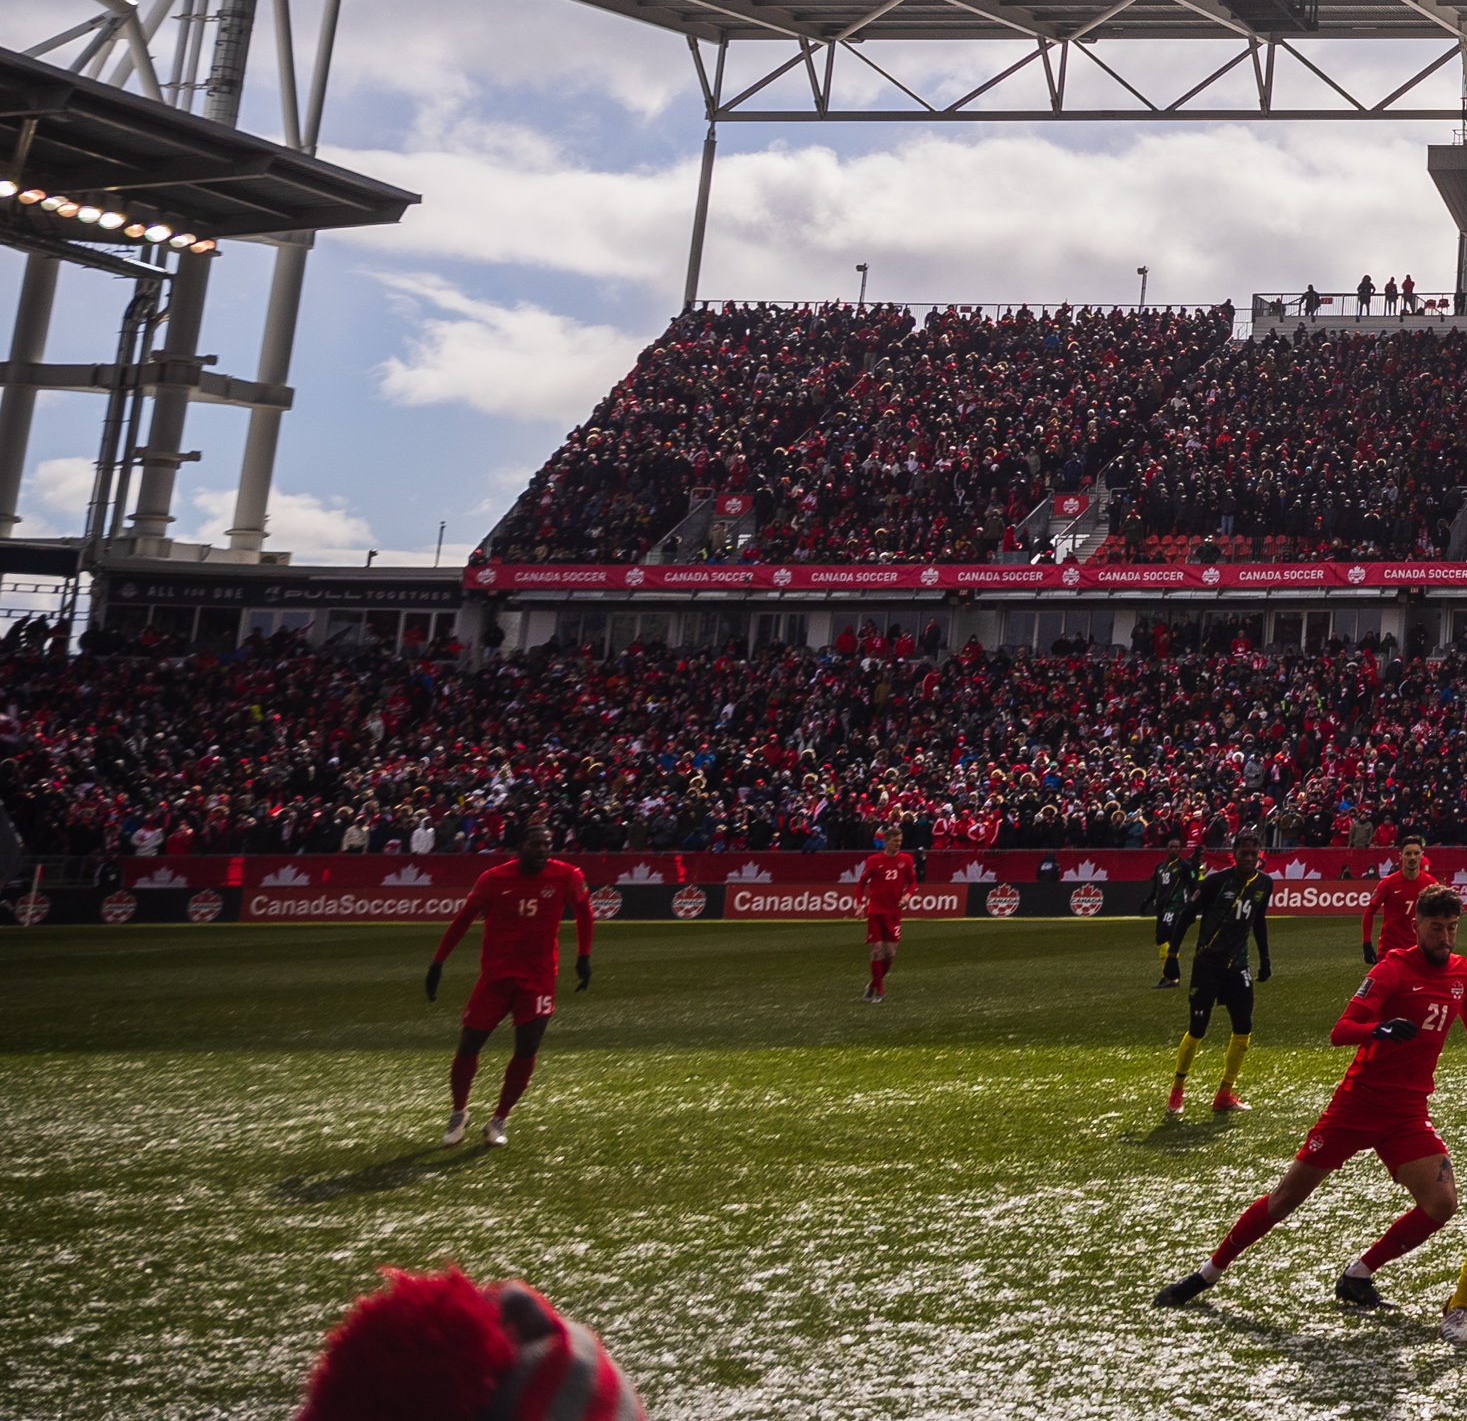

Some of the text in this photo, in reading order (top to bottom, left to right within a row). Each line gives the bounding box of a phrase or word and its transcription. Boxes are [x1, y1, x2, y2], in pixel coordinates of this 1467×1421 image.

[514, 572, 606, 581] CANADA SOCCER
[664, 572, 754, 582] CANADA SOCCER
[811, 572, 897, 582] CANADA SOCCER
[957, 572, 1043, 582] CANADA SOCCER
[1098, 571, 1184, 581] CANADA SOCCER
[1239, 570, 1324, 581] CANADA SOCCER
[1384, 569, 1426, 580] CANADA
[147, 585, 176, 597] ALL
[365, 590, 451, 600] TOGETHER
[884, 869, 898, 881] 23
[1161, 872, 1171, 885] 18
[517, 898, 539, 918] 15
[1235, 898, 1252, 920] 14
[1404, 899, 1415, 915] 7
[1163, 911, 1174, 923] 18
[1422, 1003, 1449, 1032] 21
